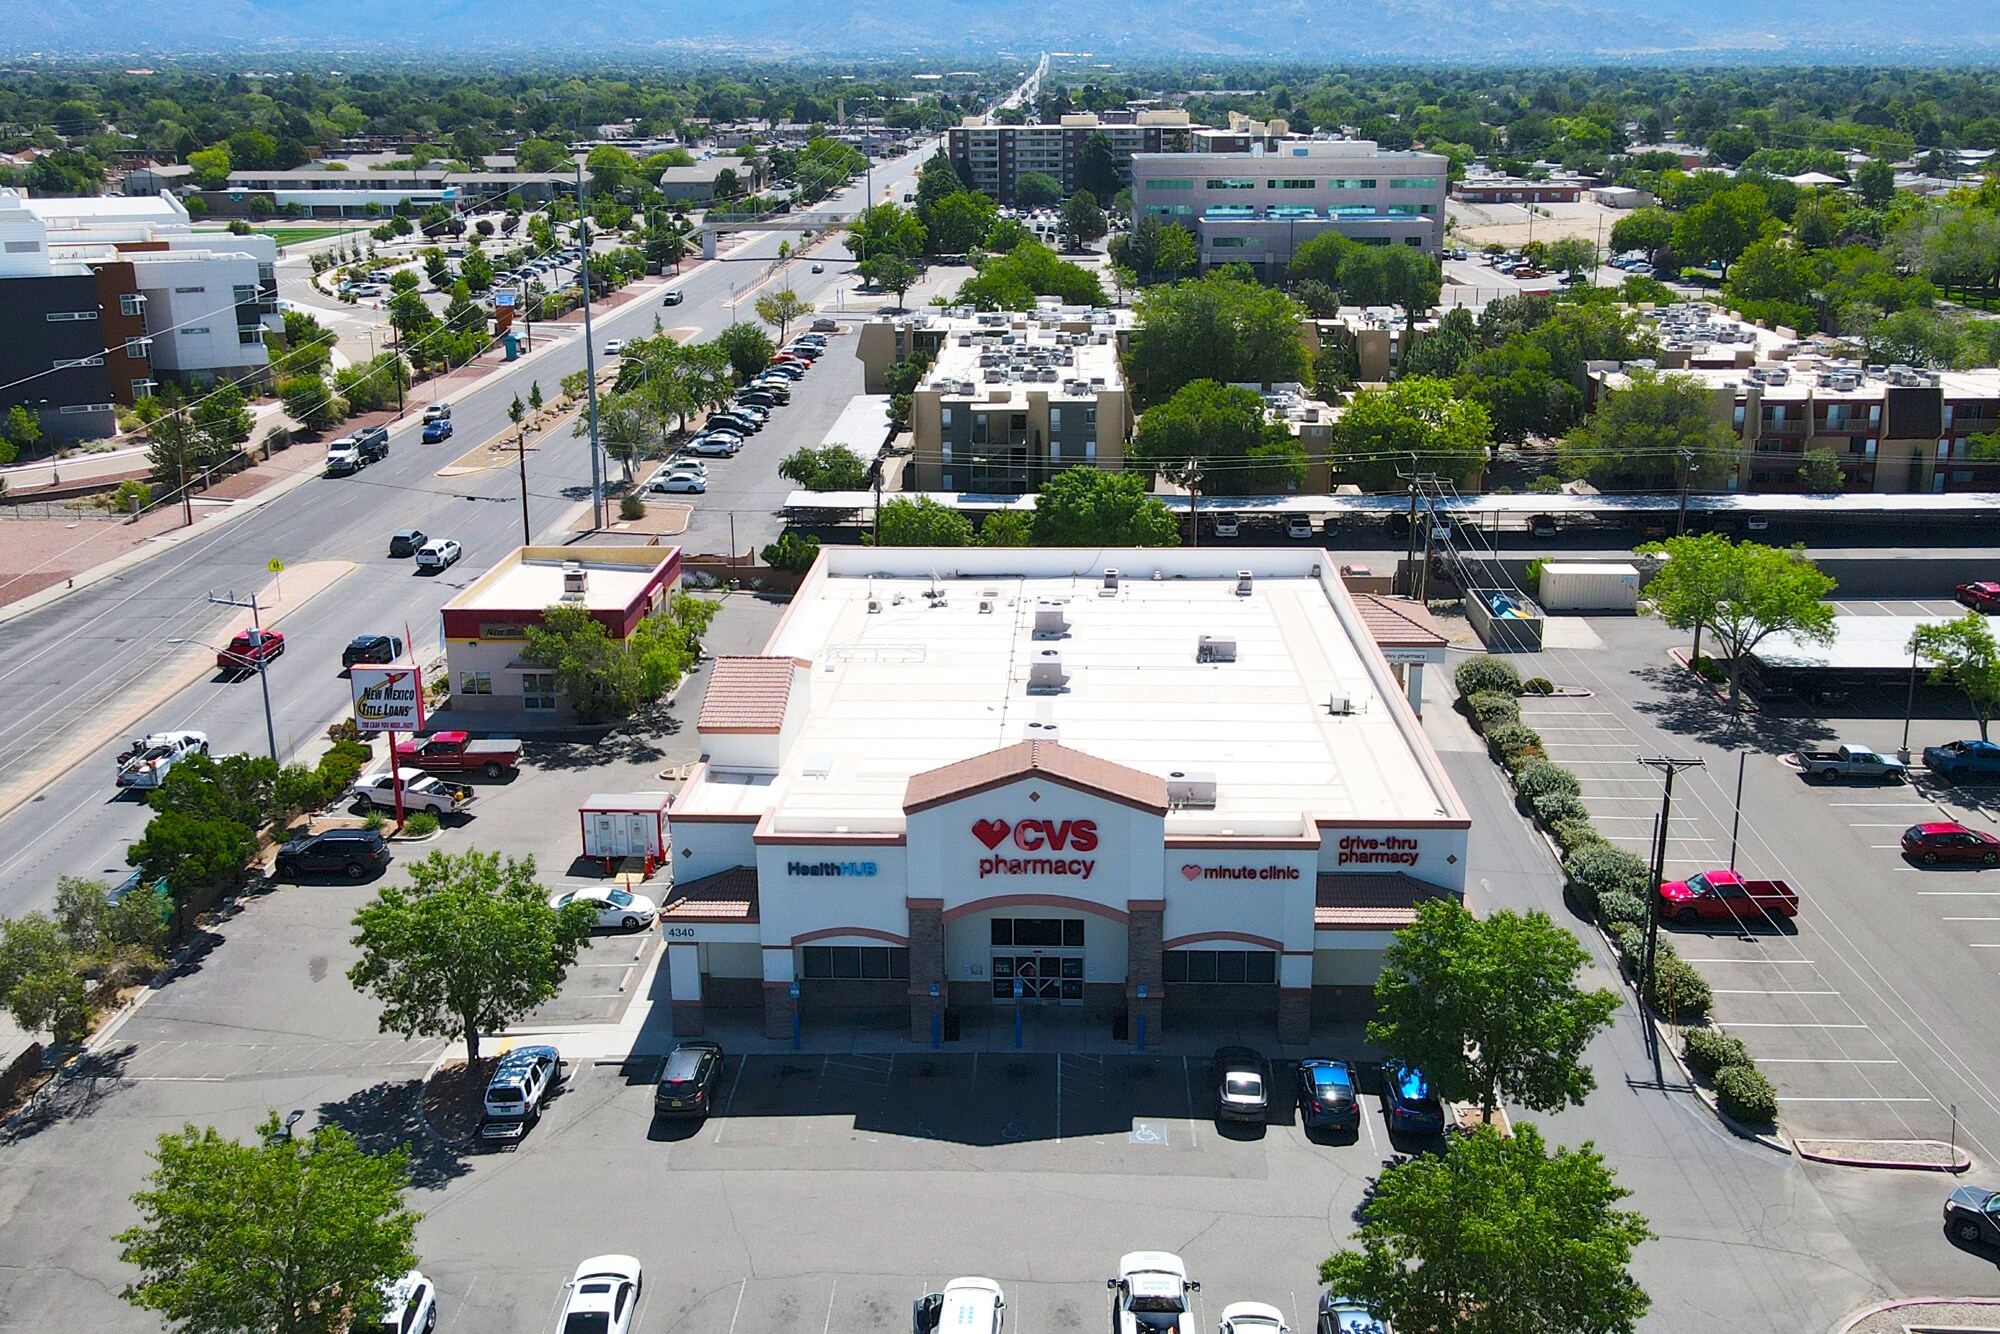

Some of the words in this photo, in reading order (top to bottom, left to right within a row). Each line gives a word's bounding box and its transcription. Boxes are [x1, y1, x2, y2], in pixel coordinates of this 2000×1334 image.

[1014, 819, 1099, 852] CVS
[1339, 835, 1418, 850] drive-thru
[1338, 849, 1419, 867] pharmacy
[787, 861, 877, 877] HealthHUB
[979, 854, 1096, 879] pharmacy
[1204, 865, 1258, 880] minute
[1259, 865, 1300, 880] clinic
[668, 928, 695, 938] 4340
